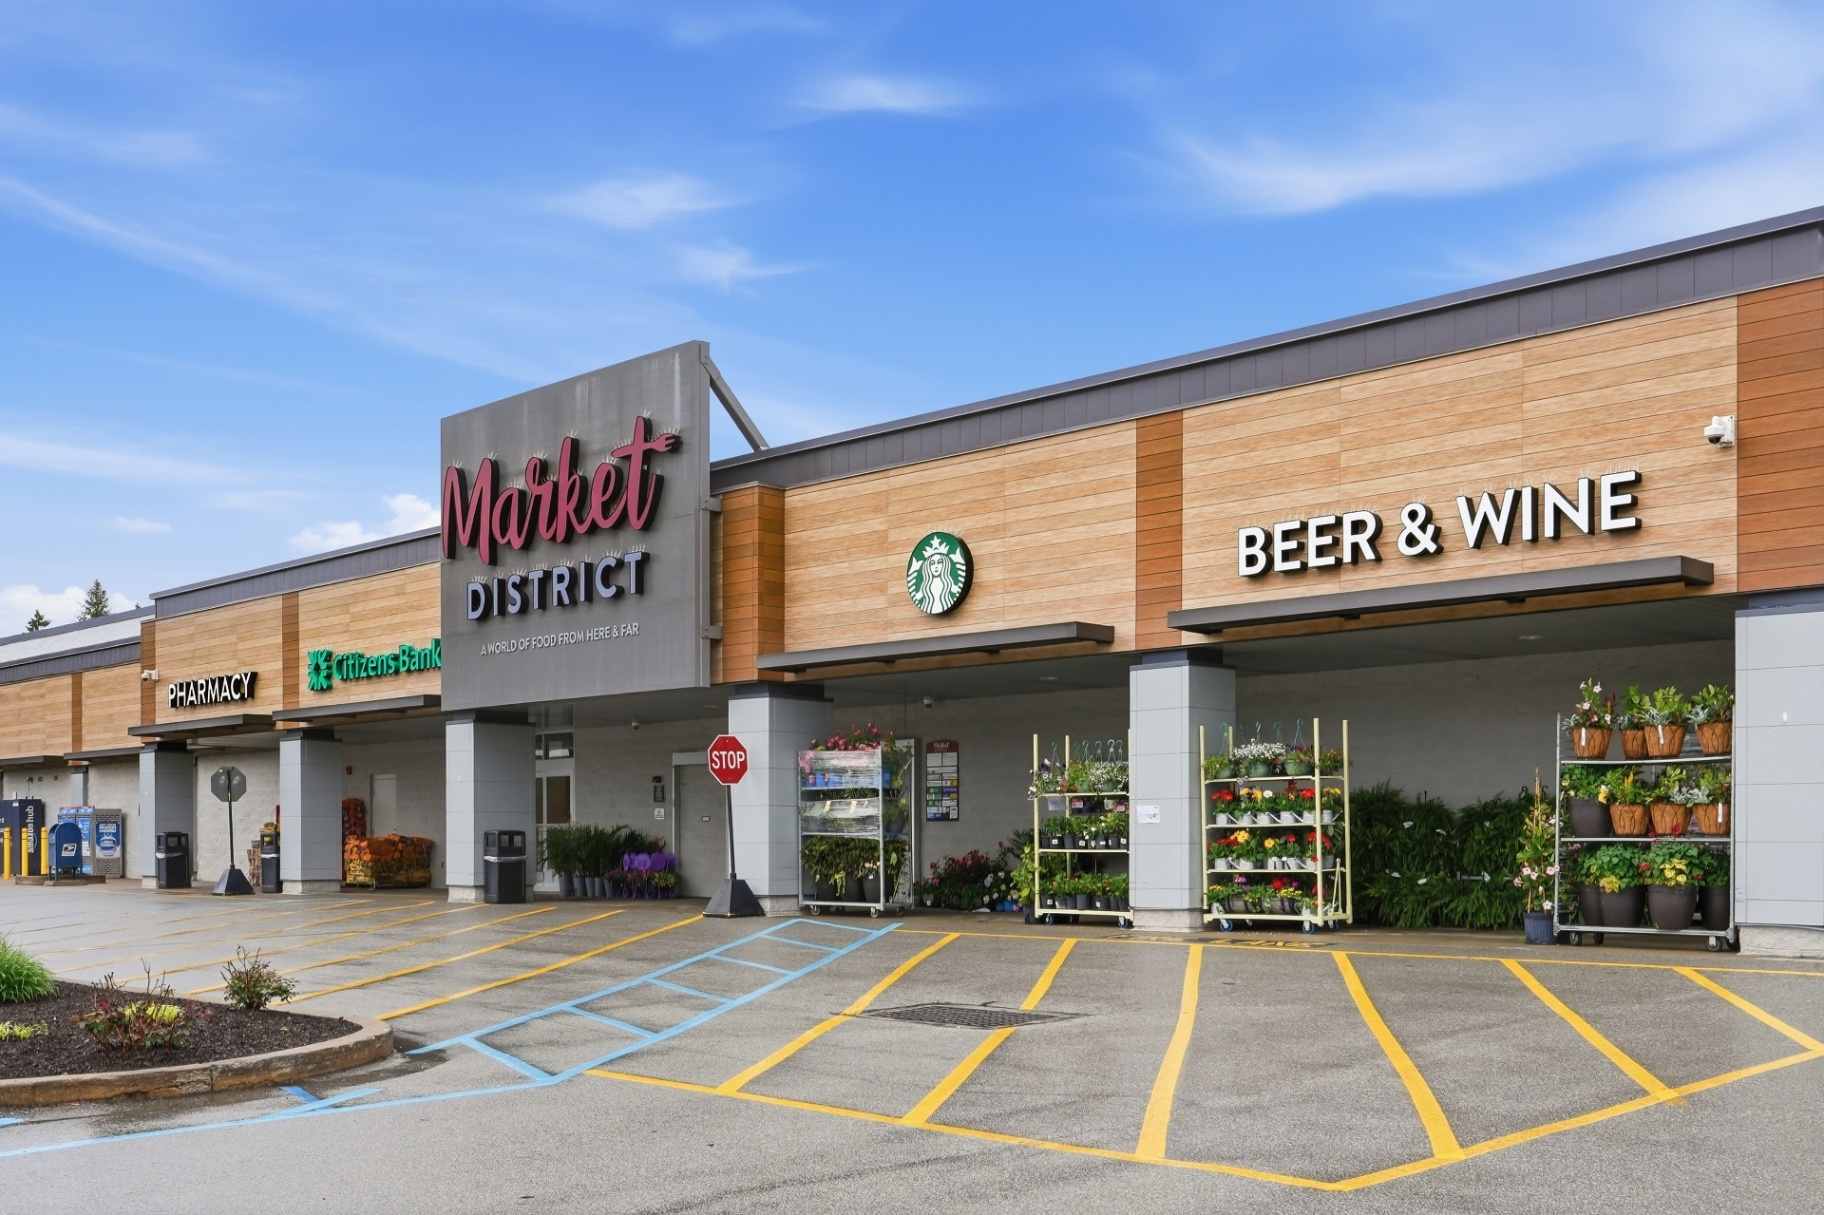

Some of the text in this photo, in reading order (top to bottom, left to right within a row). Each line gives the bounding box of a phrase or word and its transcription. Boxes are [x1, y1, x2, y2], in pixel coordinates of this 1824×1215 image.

[442, 416, 682, 565] Market
[1238, 470, 1642, 577] BEER & WINE
[467, 552, 650, 621] DISTRICT
[481, 622, 639, 656] A WORLD OF FOOD FROM HERE & FAR
[332, 638, 442, 681] Citizens Bank
[168, 671, 254, 708] PHARMACY
[712, 751, 746, 769] STOP
[25, 805, 34, 822] hub
